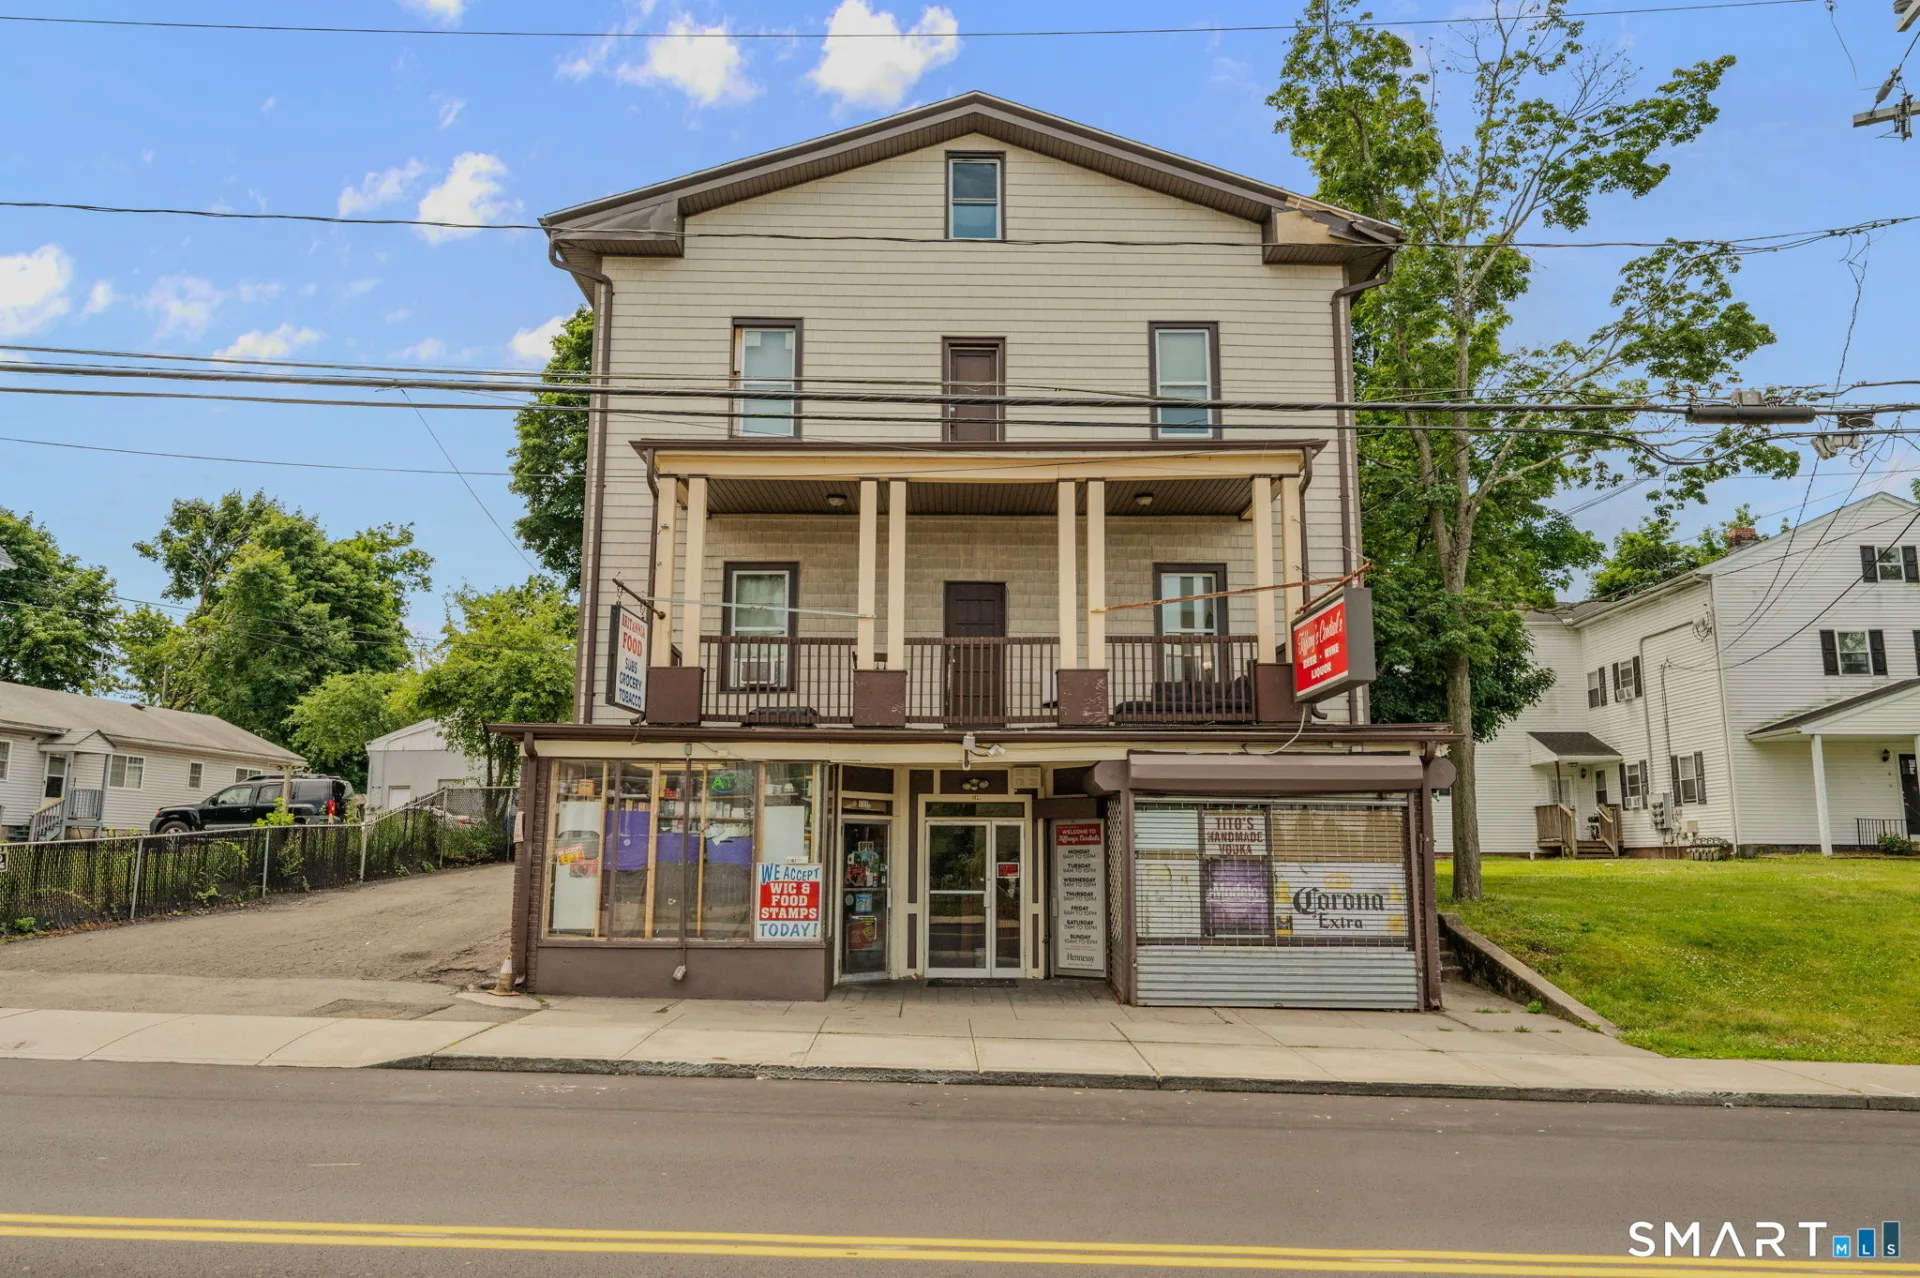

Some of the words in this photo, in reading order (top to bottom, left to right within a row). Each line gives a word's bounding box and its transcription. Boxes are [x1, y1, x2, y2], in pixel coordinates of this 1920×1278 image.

[622, 614, 645, 638] BRITANNIA
[622, 632, 642, 657] FOOD
[1303, 654, 1317, 669] BEER
[1324, 643, 1340, 658] WINE
[625, 657, 638, 674] SUBS
[1311, 661, 1332, 680] LIQUOR
[619, 672, 642, 692] GROCERY
[619, 688, 641, 708] TOBACCO
[1215, 817, 1254, 830] TITO'S
[1206, 831, 1263, 843] HANDMADE
[1219, 844, 1253, 856] VODKA
[761, 863, 780, 884] WE
[783, 866, 821, 881] ACCEPT
[770, 883, 797, 894] WIC
[801, 883, 811, 894] &
[1211, 882, 1260, 898] Modelo
[771, 895, 808, 907] FOOD
[1293, 887, 1385, 917] Corona
[761, 907, 817, 919] STAMPS
[1318, 912, 1363, 929] Extra
[759, 923, 818, 938] TODAY!
[1067, 952, 1095, 963] Hennessy
